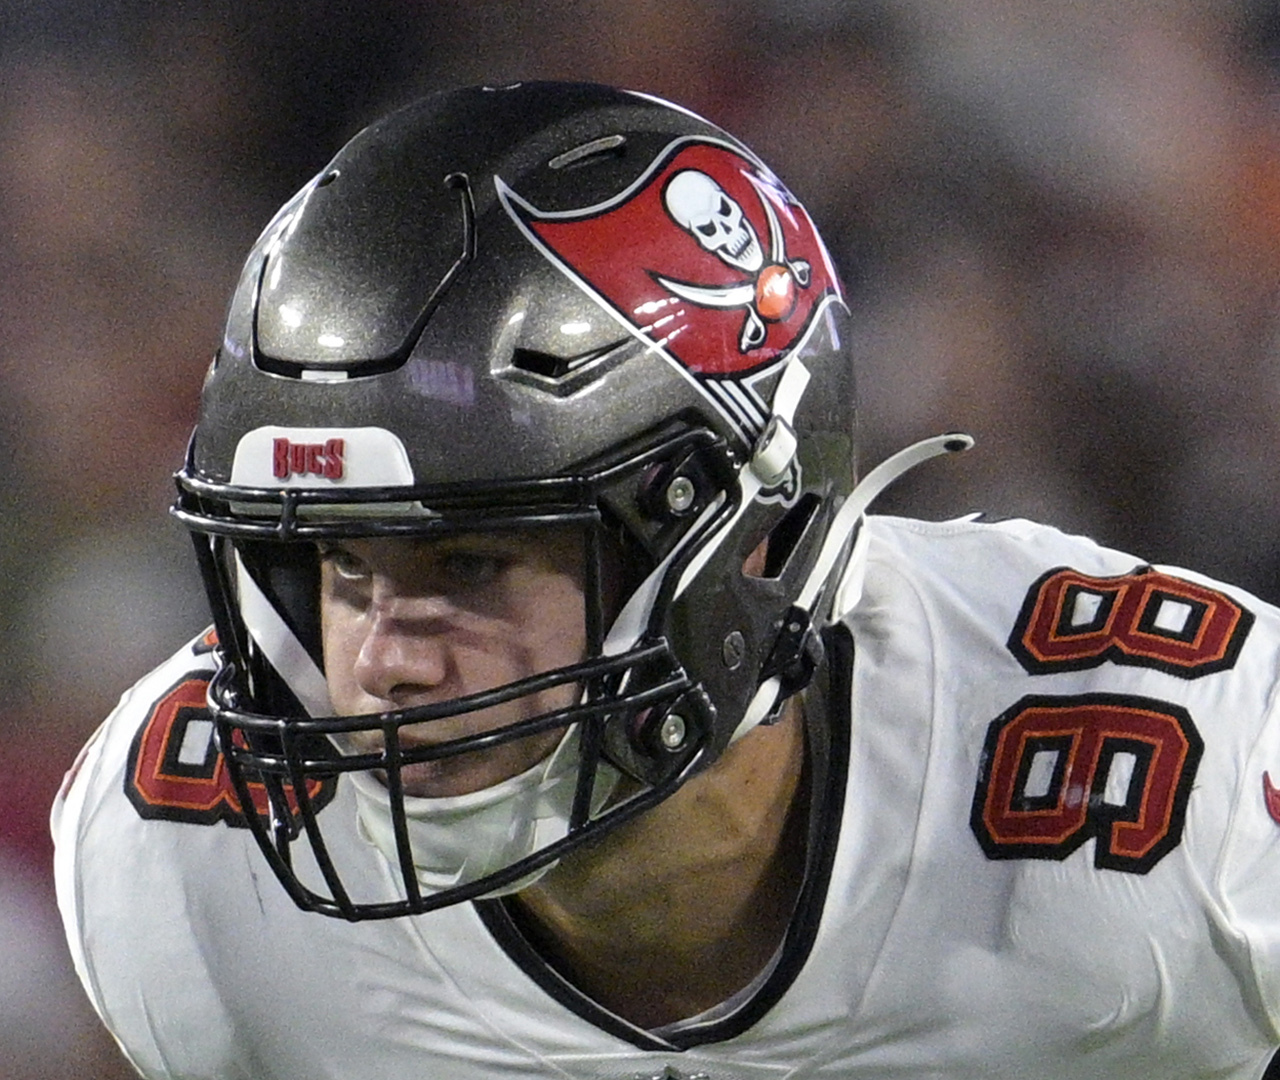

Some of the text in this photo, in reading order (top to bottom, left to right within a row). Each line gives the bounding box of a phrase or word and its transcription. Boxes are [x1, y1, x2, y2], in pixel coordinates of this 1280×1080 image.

[273, 437, 345, 479] BUCS
[122, 630, 338, 841] 8
[969, 565, 1256, 875] 98
